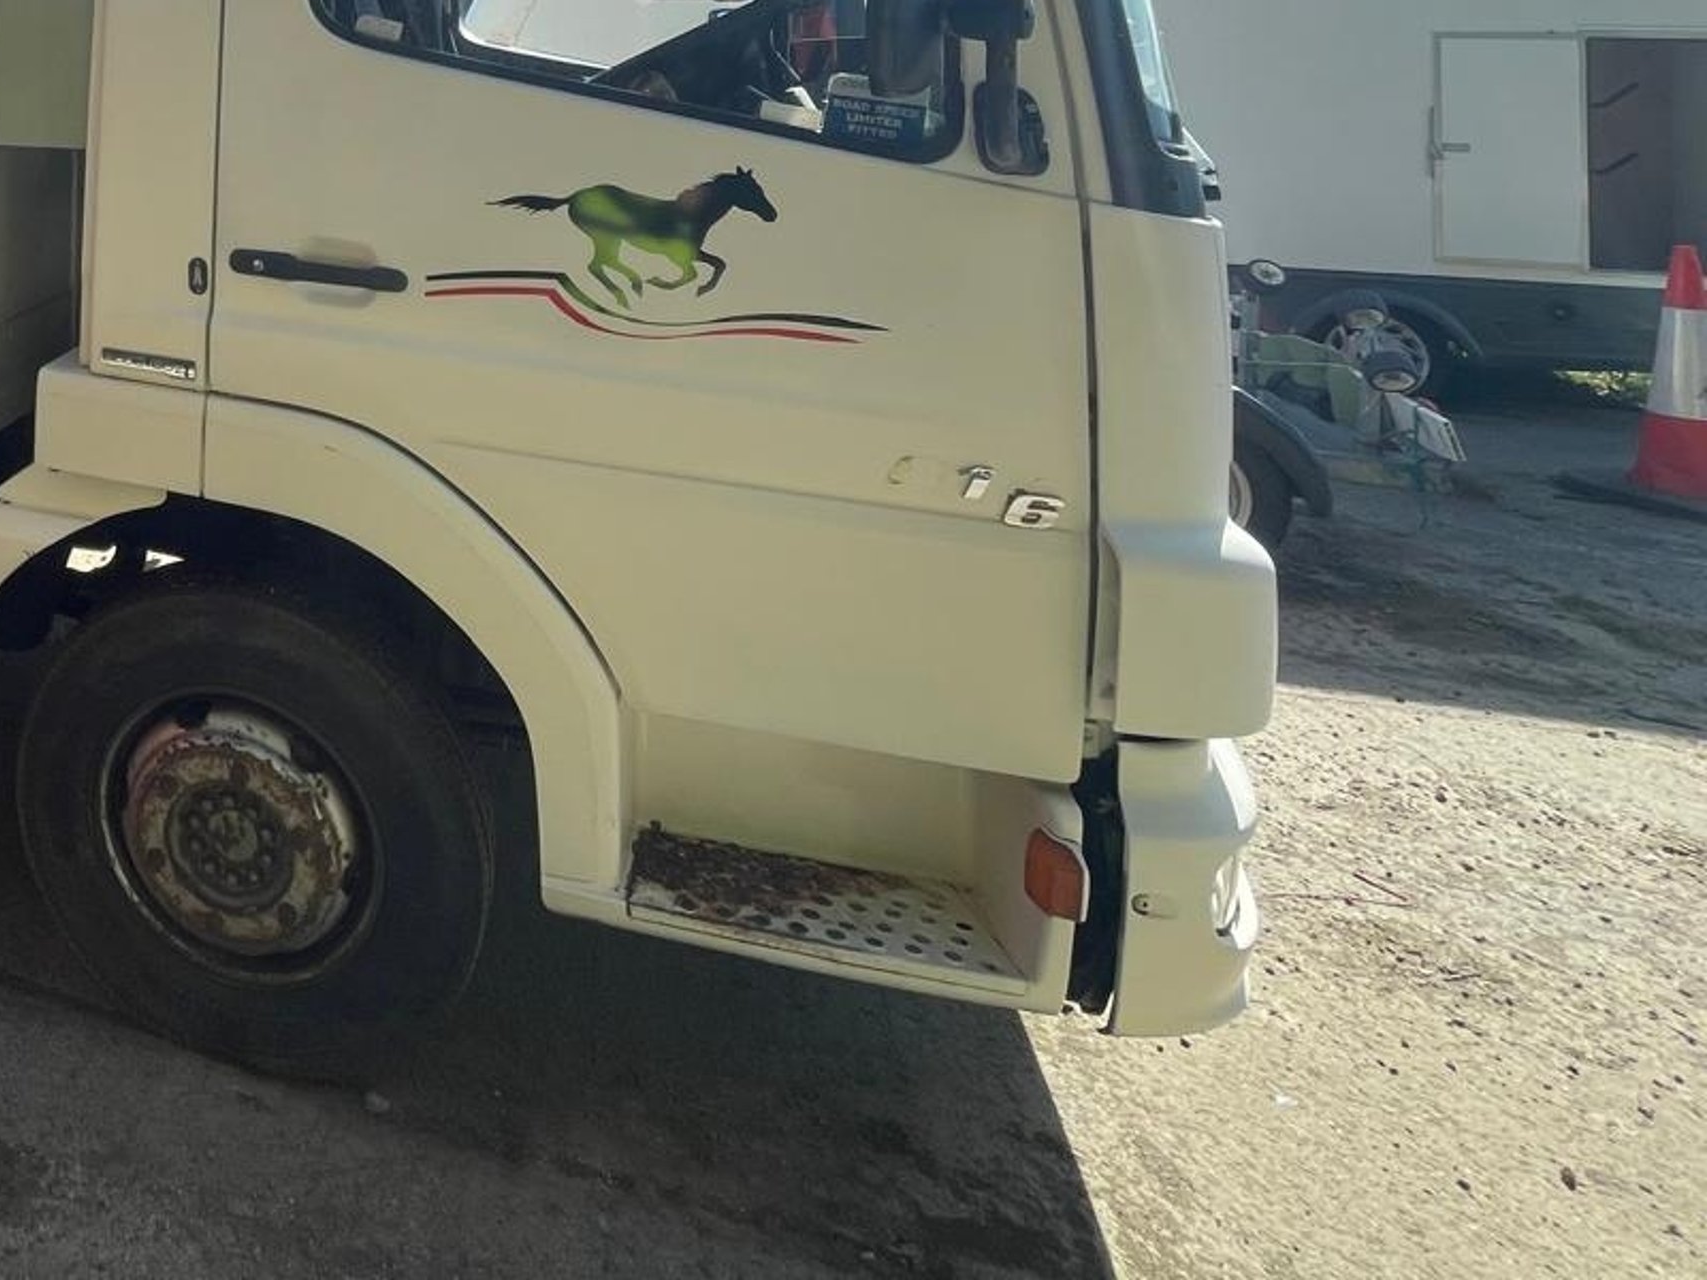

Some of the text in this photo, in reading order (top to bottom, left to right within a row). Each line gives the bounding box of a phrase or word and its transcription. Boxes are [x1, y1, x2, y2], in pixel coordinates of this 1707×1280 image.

[832, 98, 871, 112] ROAD
[845, 111, 903, 129] LIMITER
[847, 123, 898, 140] FITTED
